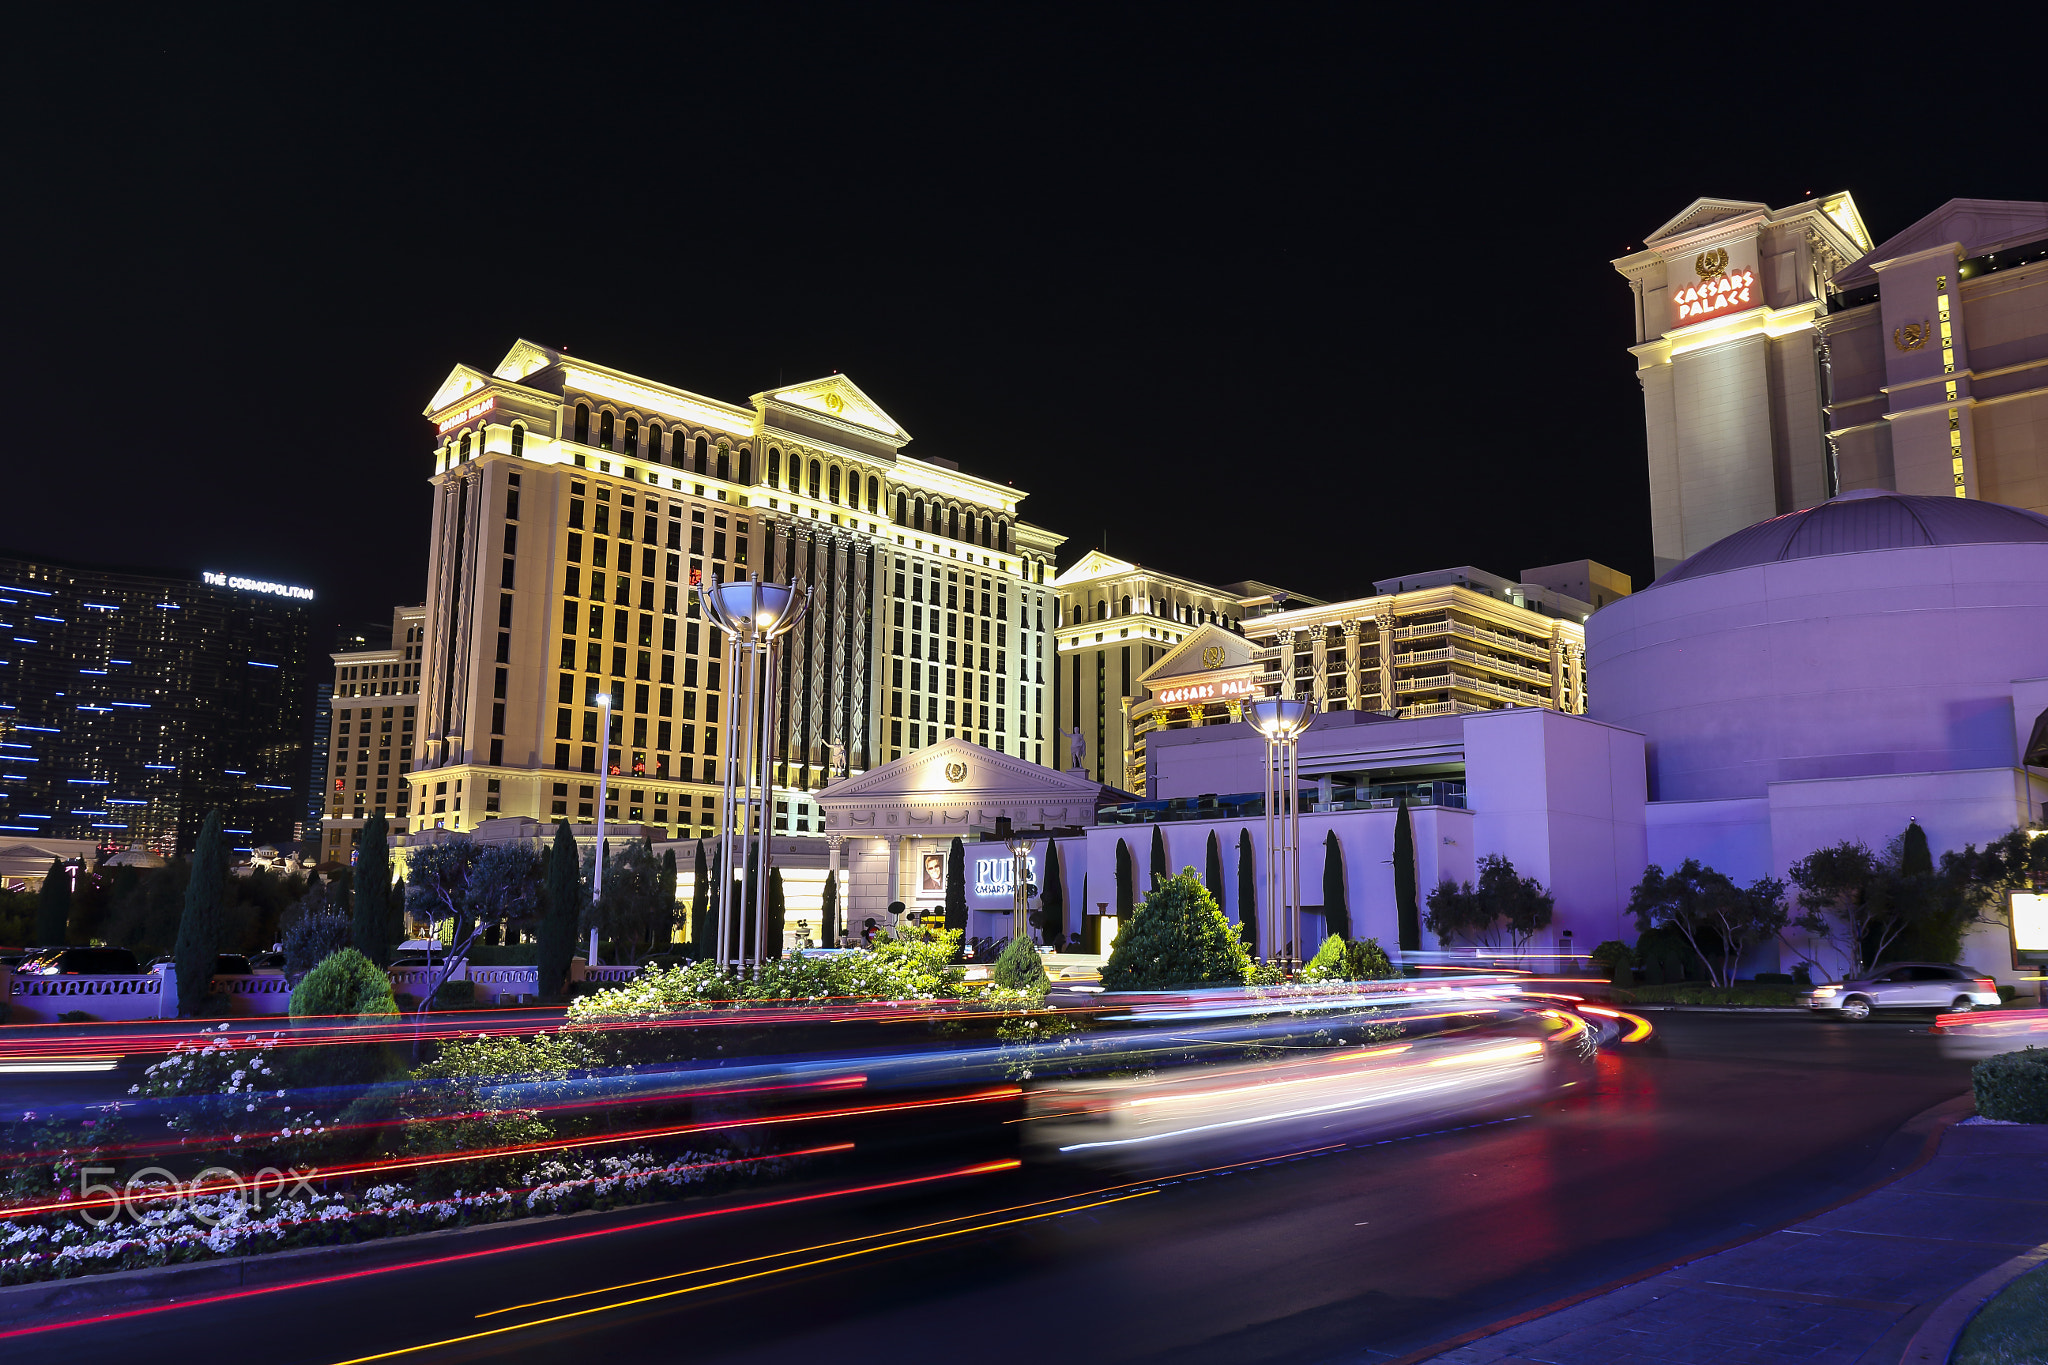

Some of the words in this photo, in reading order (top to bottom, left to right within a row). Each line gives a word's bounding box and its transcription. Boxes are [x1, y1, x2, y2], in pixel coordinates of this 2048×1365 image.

[1674, 271, 1754, 305] CAESARS
[1679, 287, 1750, 319] PALACE
[203, 572, 227, 587] THE
[228, 576, 314, 600] COSMOPOLITAN
[1160, 684, 1215, 704] CAESARS
[1222, 679, 1263, 695] PALA
[974, 884, 1005, 895] CAESARS
